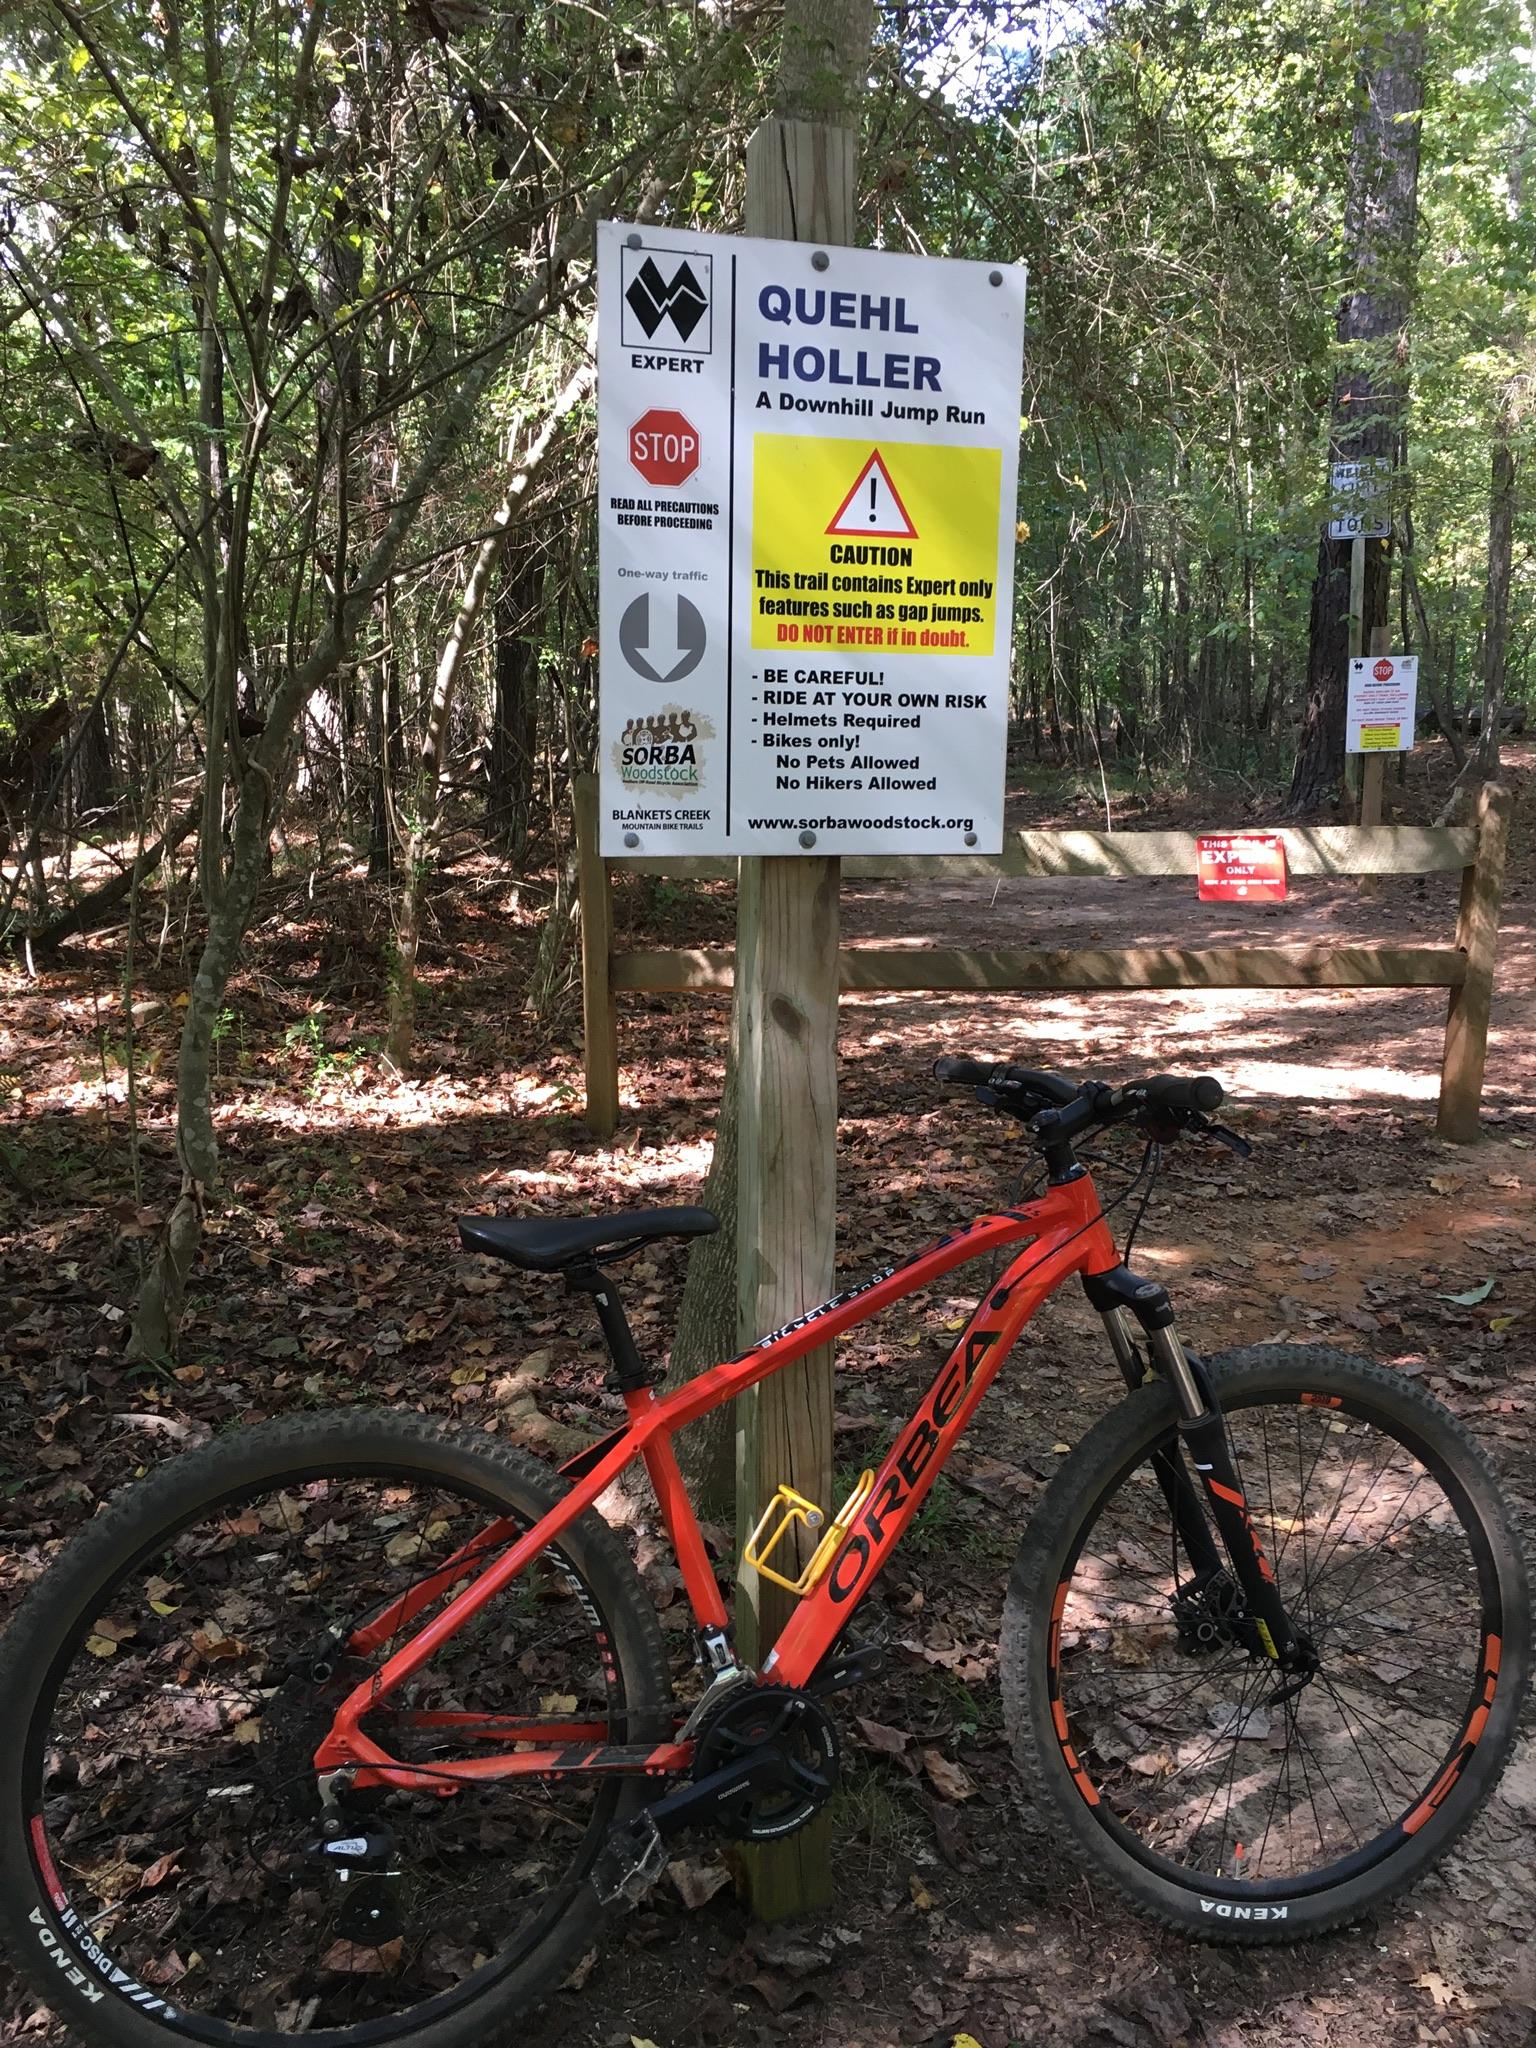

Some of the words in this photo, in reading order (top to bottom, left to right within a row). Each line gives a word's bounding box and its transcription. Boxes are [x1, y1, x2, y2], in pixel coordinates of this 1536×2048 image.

[758, 284, 919, 334] QUEHL
[631, 354, 704, 374] EXPERT
[758, 342, 943, 392] HOLLER
[755, 391, 772, 409] A
[779, 392, 873, 417] Downhill
[880, 401, 939, 425] Jump
[946, 406, 985, 424] Run
[634, 432, 695, 463] STOP
[610, 498, 636, 511] READ
[637, 499, 653, 511] ALL
[654, 500, 719, 515] PRECAUTIONS
[617, 514, 652, 527] BEFORE
[654, 515, 713, 530] PROCEEDING
[830, 544, 912, 567] CAUTION
[618, 567, 669, 581] One-way
[672, 570, 708, 581] traffic
[755, 569, 791, 590] This
[794, 571, 828, 591] trail
[832, 573, 903, 594] contains
[906, 576, 956, 597] Expert
[959, 579, 993, 600] only
[759, 596, 829, 617] features
[832, 600, 872, 619] such
[876, 605, 895, 620] as
[898, 606, 928, 623] gap
[931, 603, 984, 624] jumps.
[777, 624, 799, 642] DO
[803, 624, 834, 643] NOT
[837, 626, 883, 645] ENTER
[887, 627, 898, 645] if
[901, 628, 917, 646] in
[920, 629, 970, 648] doubt.
[764, 669, 788, 683] BE
[794, 670, 884, 686] CAREFUL!
[1374, 666, 1393, 676] STOP
[764, 691, 807, 706] RIDE
[813, 692, 835, 706] AT
[842, 693, 892, 707] YOUR
[898, 694, 939, 708] OWN
[945, 695, 987, 709] RISK
[763, 712, 837, 727] Helmets
[843, 713, 921, 731] Required
[763, 733, 812, 747] Bikes
[817, 735, 860, 751] only!
[621, 744, 697, 766] SORBA
[776, 755, 800, 769] No
[806, 755, 845, 769] Pets
[850, 756, 920, 770] Allowed
[621, 766, 698, 781] Woodstock
[776, 776, 800, 790] No
[806, 776, 863, 790] Hikers
[868, 777, 937, 791] Allowed
[612, 809, 673, 820] BLANKETS
[675, 809, 711, 820] CREEK
[748, 816, 973, 831] www.sorbawoodstock.org
[622, 823, 662, 831] MOUNTAIN
[663, 823, 678, 831] BIKE
[679, 823, 704, 831] TRAILS
[1202, 840, 1228, 848] THIS
[1202, 851, 1278, 864] EXP
[1226, 866, 1256, 875] ONLY
[828, 1331, 1002, 1603] ORBEA
[565, 1574, 602, 1626] WTB
[1199, 1899, 1289, 1920] KENDA
[28, 1906, 105, 2004] KENDA
[80, 1931, 112, 1973] DISC
